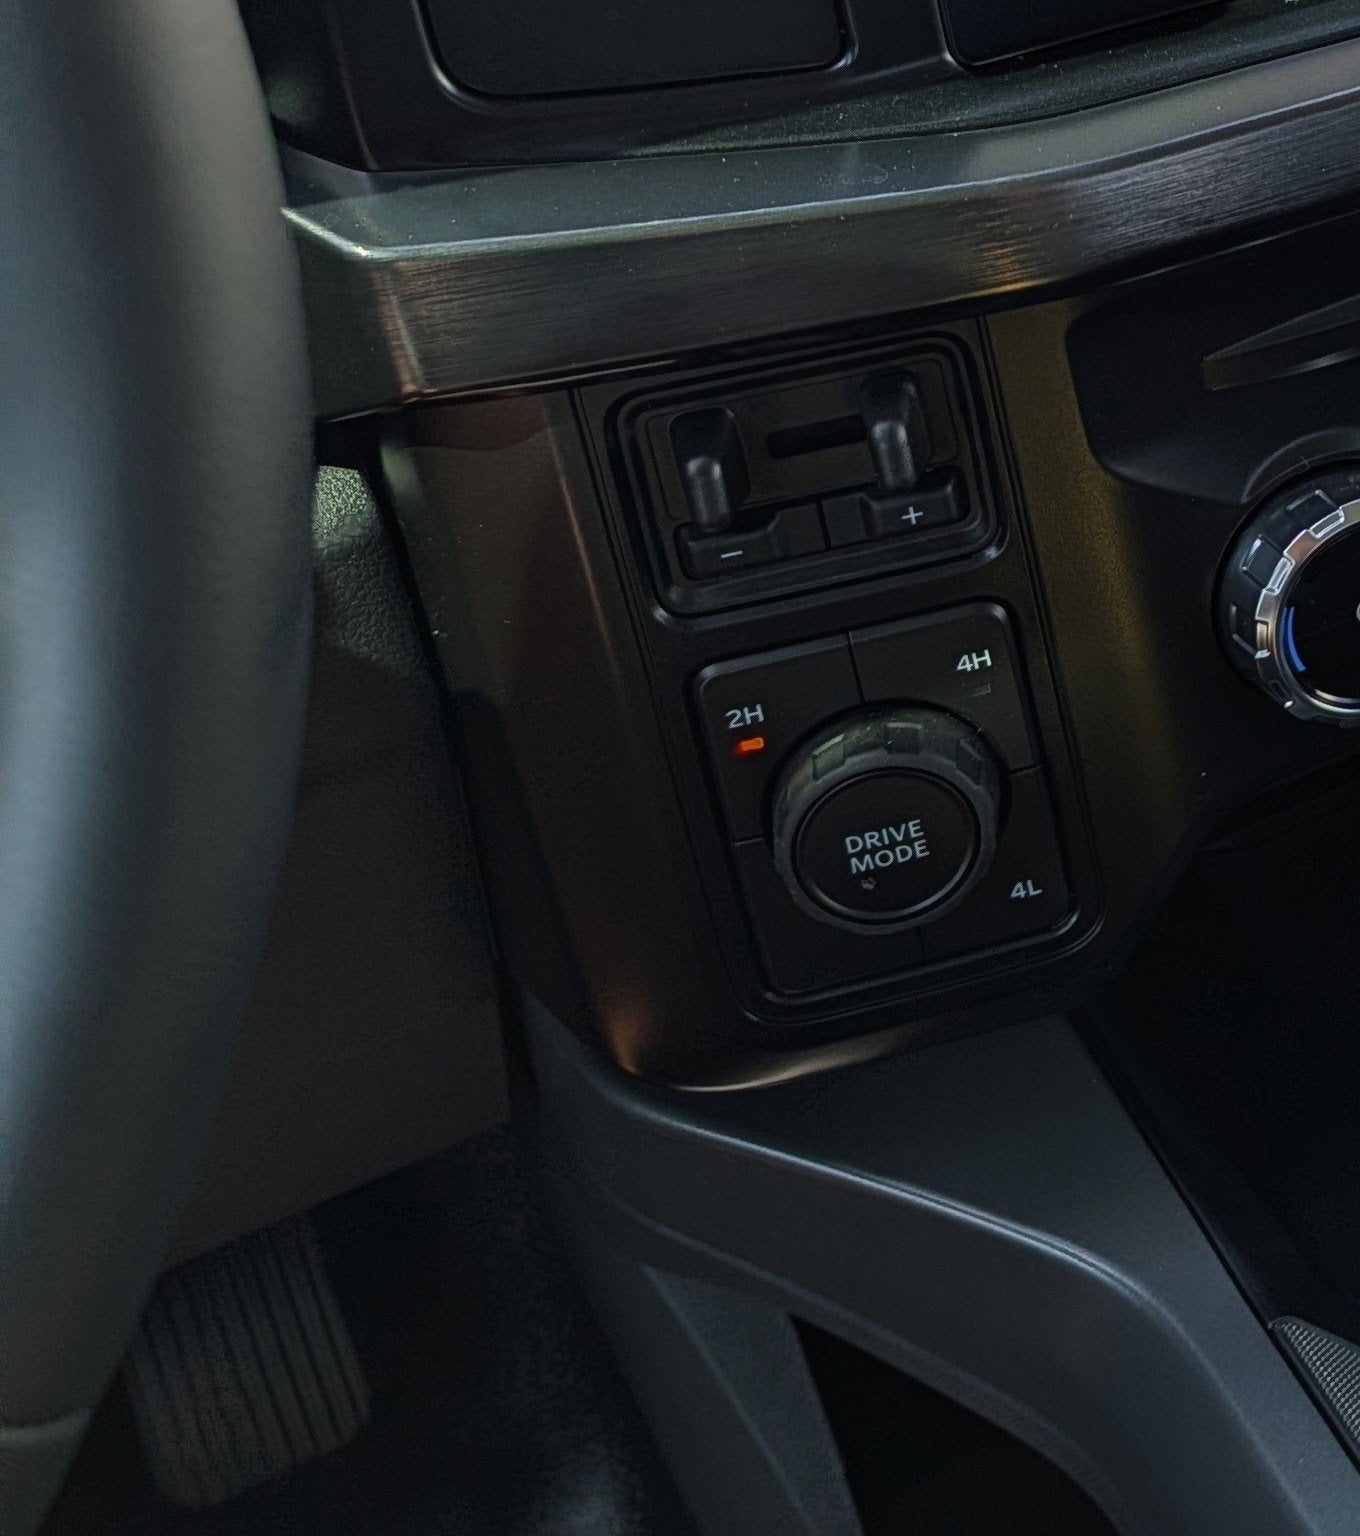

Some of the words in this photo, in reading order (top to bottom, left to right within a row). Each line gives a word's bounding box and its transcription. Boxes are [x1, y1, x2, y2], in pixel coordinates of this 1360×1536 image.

[956, 648, 993, 673] 4H
[725, 703, 765, 731] 2H
[844, 817, 925, 855] DRIVE
[849, 837, 931, 875] MODE
[1010, 878, 1043, 900] 4L
